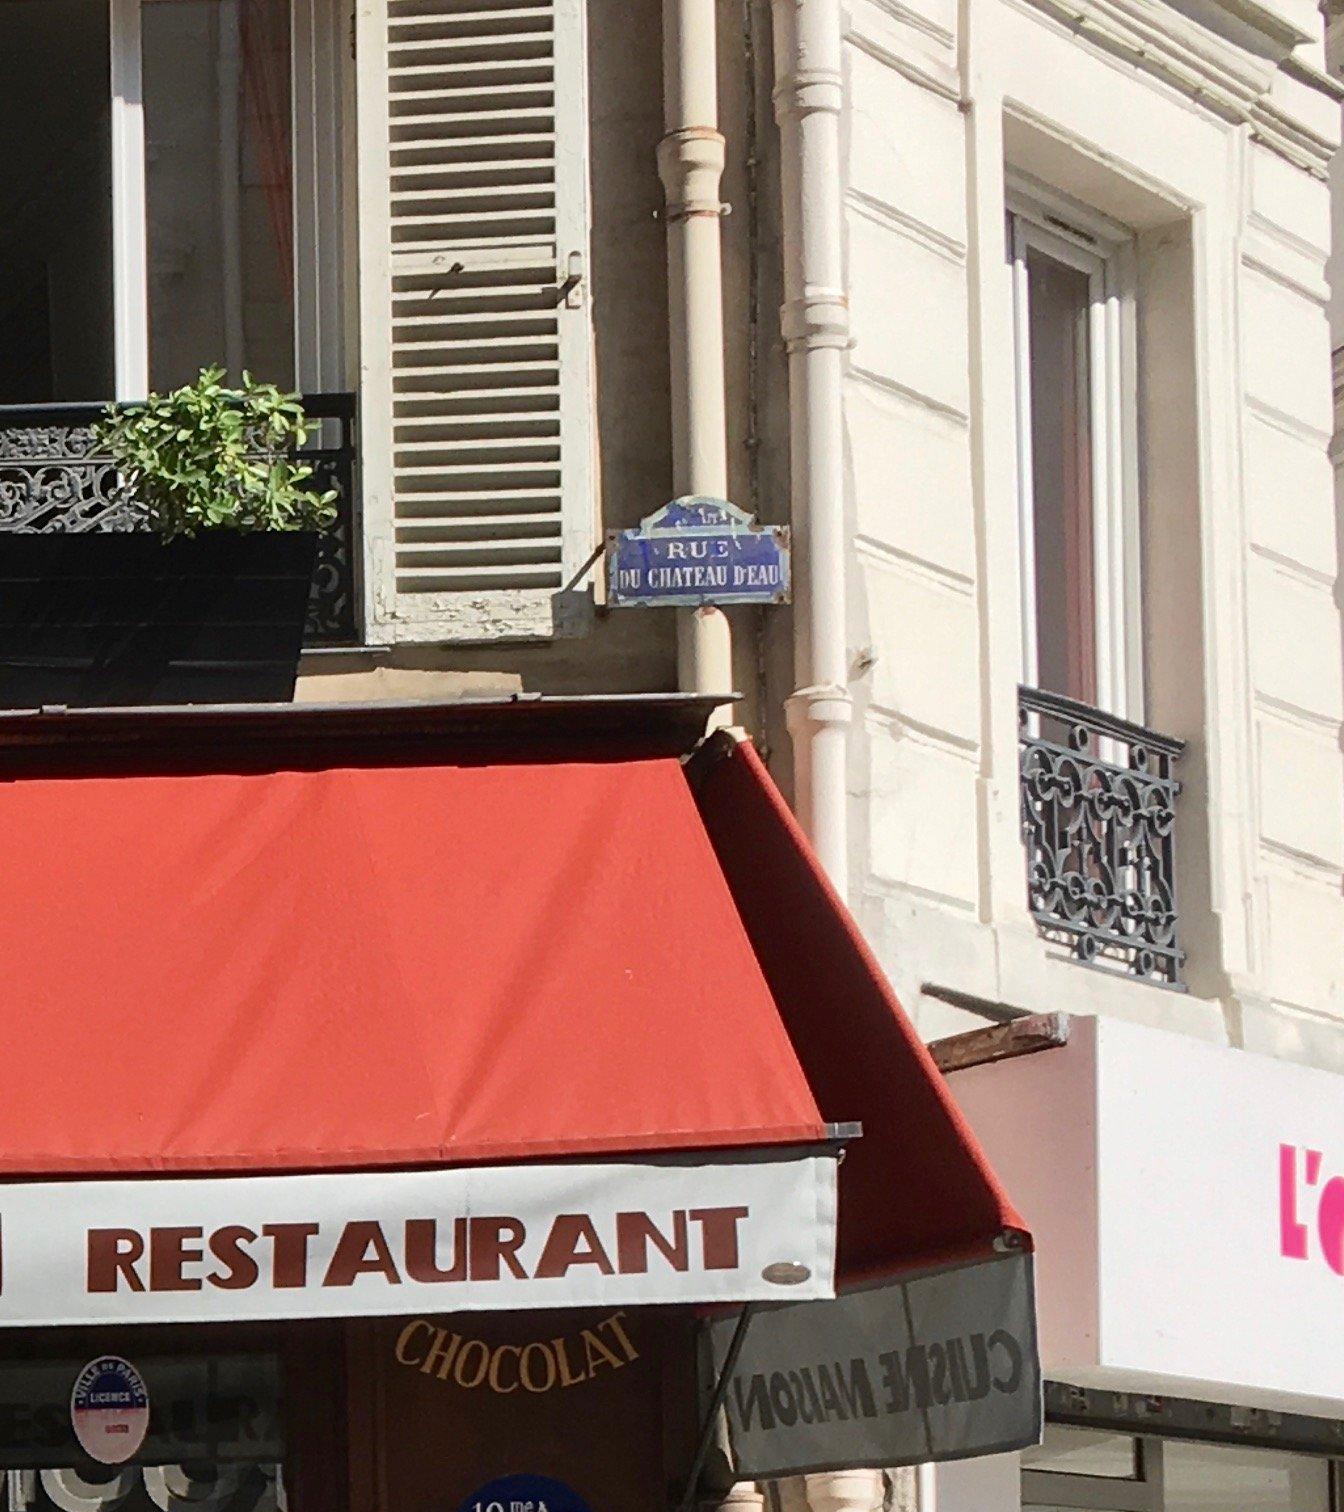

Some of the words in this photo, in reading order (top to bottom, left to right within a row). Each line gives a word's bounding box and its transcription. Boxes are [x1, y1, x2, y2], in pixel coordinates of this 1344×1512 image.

[667, 541, 729, 559] RUE
[620, 568, 641, 590] DU
[648, 565, 727, 589] CHATEAU
[86, 1206, 748, 1294] RESTAURANT
[395, 1311, 639, 1393] CHOCOLAT
[75, 1364, 100, 1398] VILLE
[116, 1362, 144, 1397] PARIS
